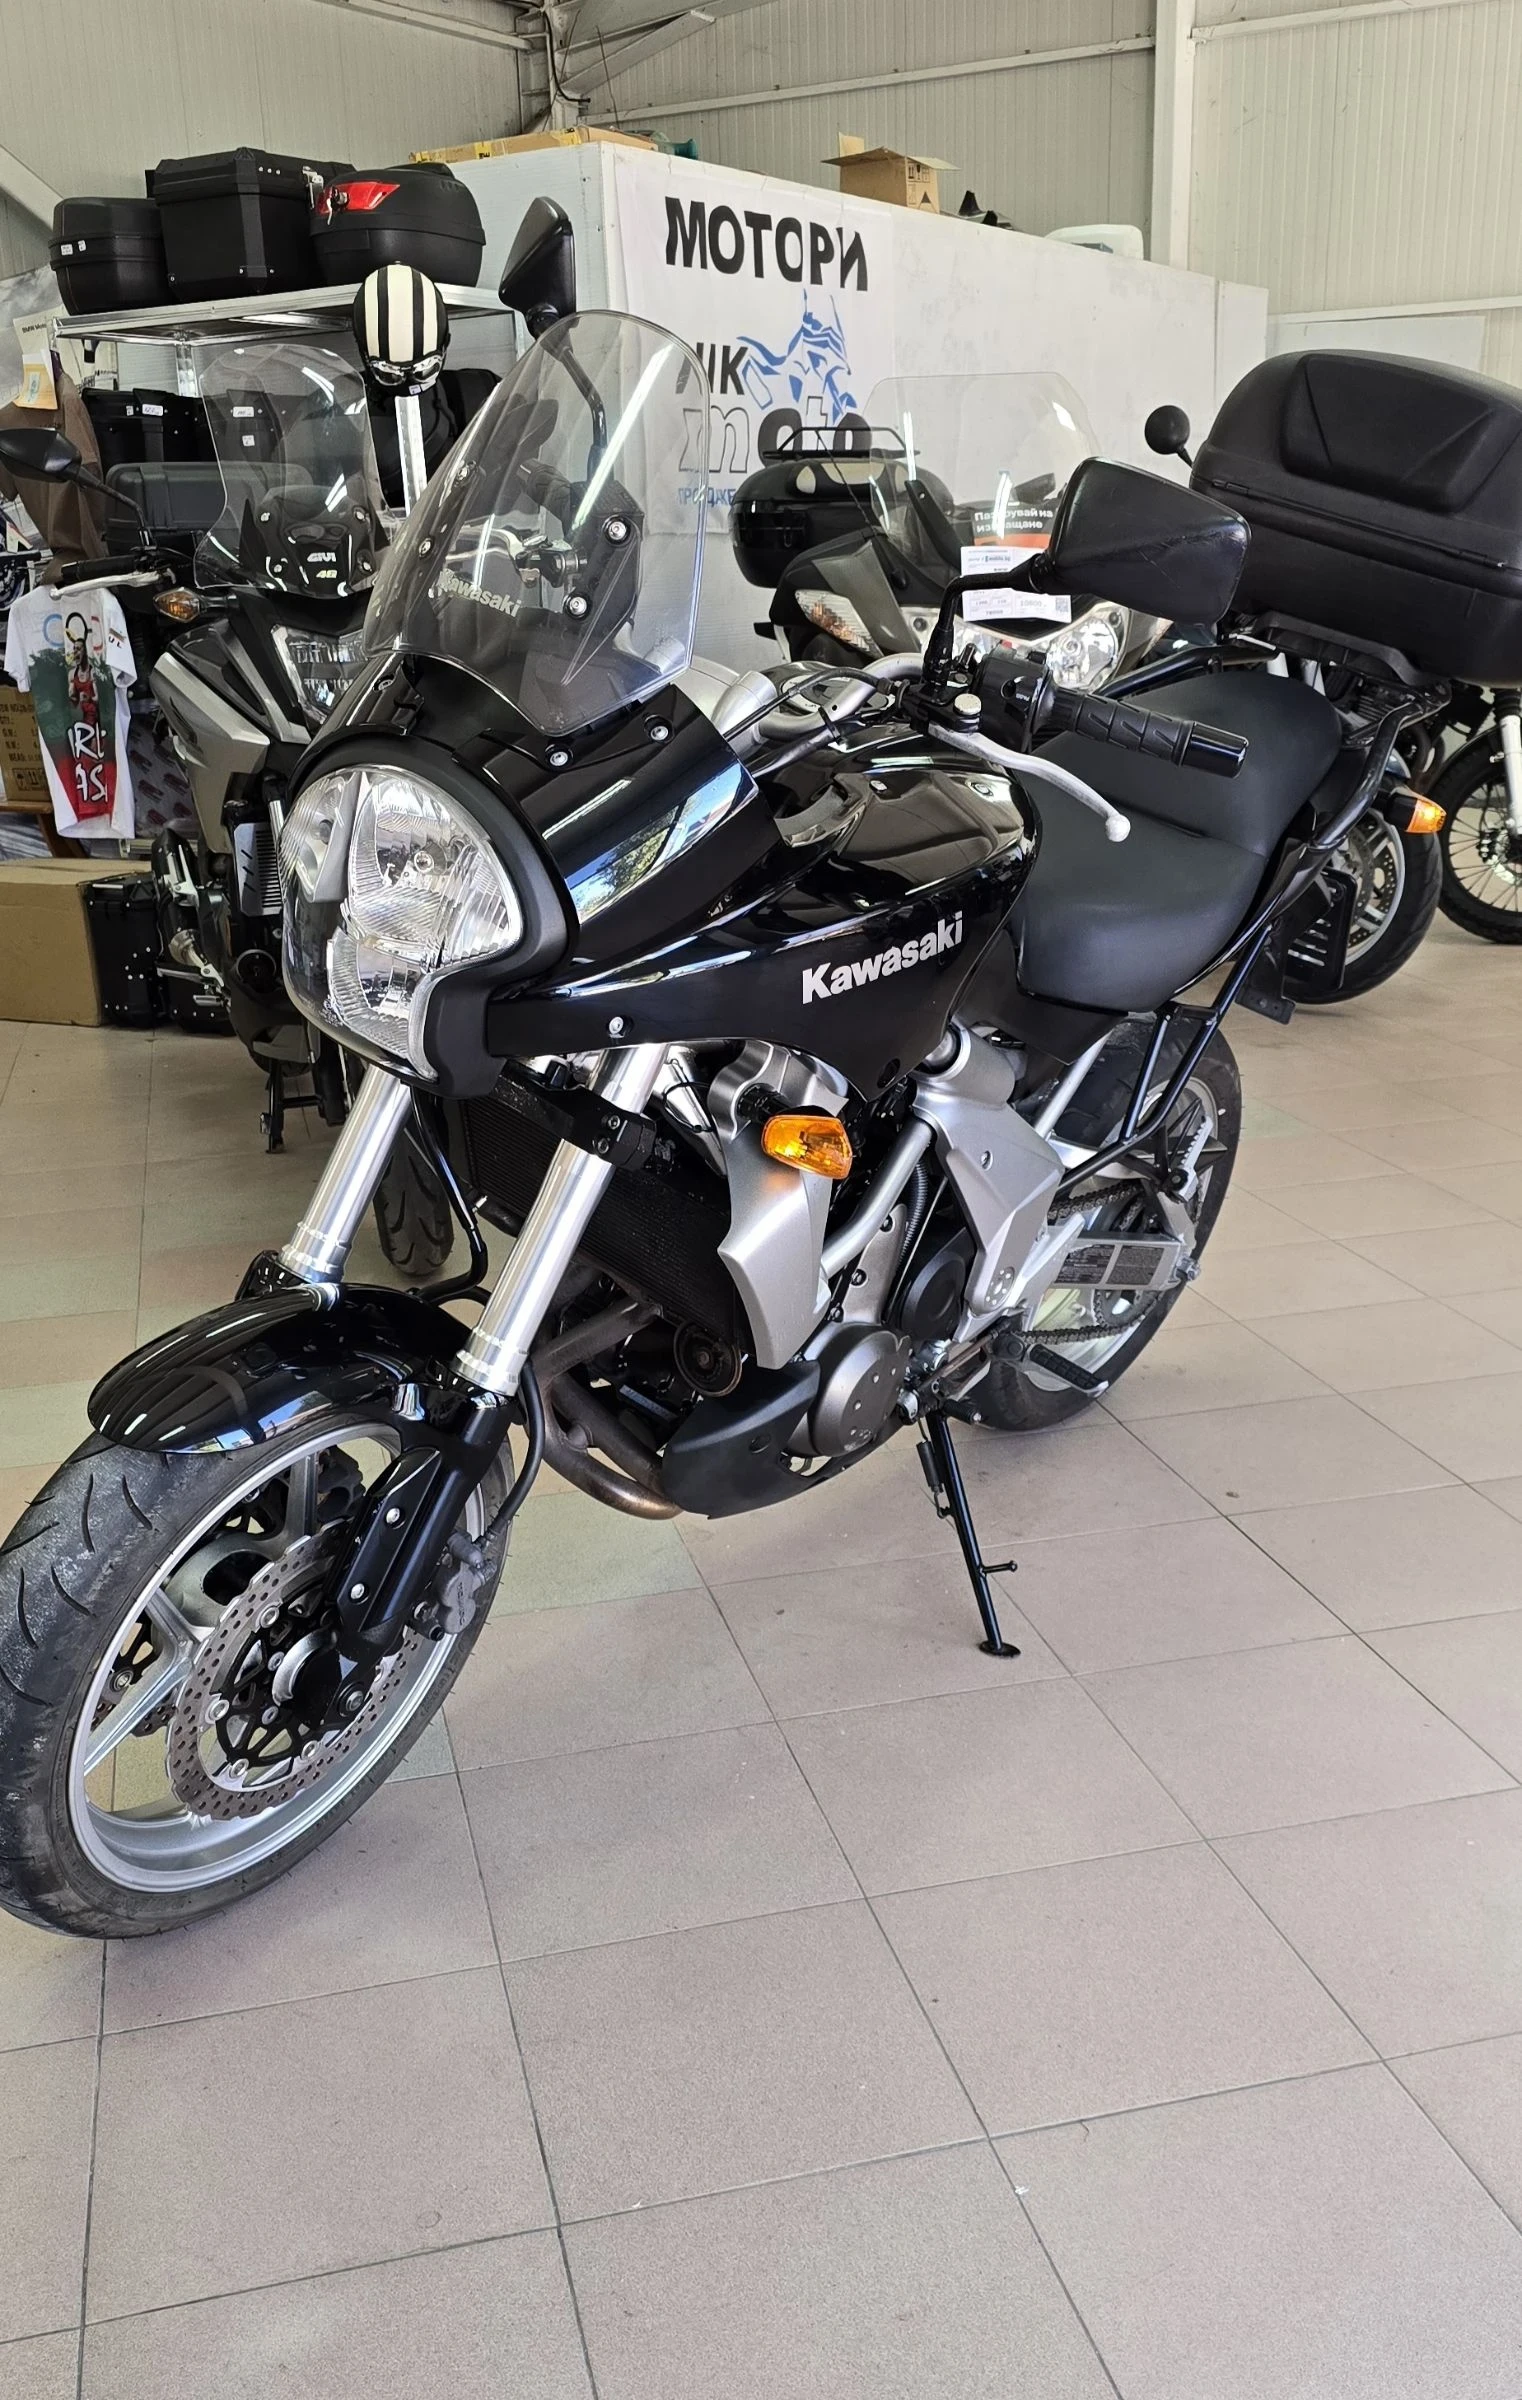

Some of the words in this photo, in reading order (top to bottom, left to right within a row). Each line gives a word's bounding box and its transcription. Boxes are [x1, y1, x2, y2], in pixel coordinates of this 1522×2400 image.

[665, 196, 868, 291] МОТОРИ
[307, 552, 337, 562] GIVI
[438, 568, 522, 617] Kawasaki
[802, 910, 963, 1004] Kawasaki
